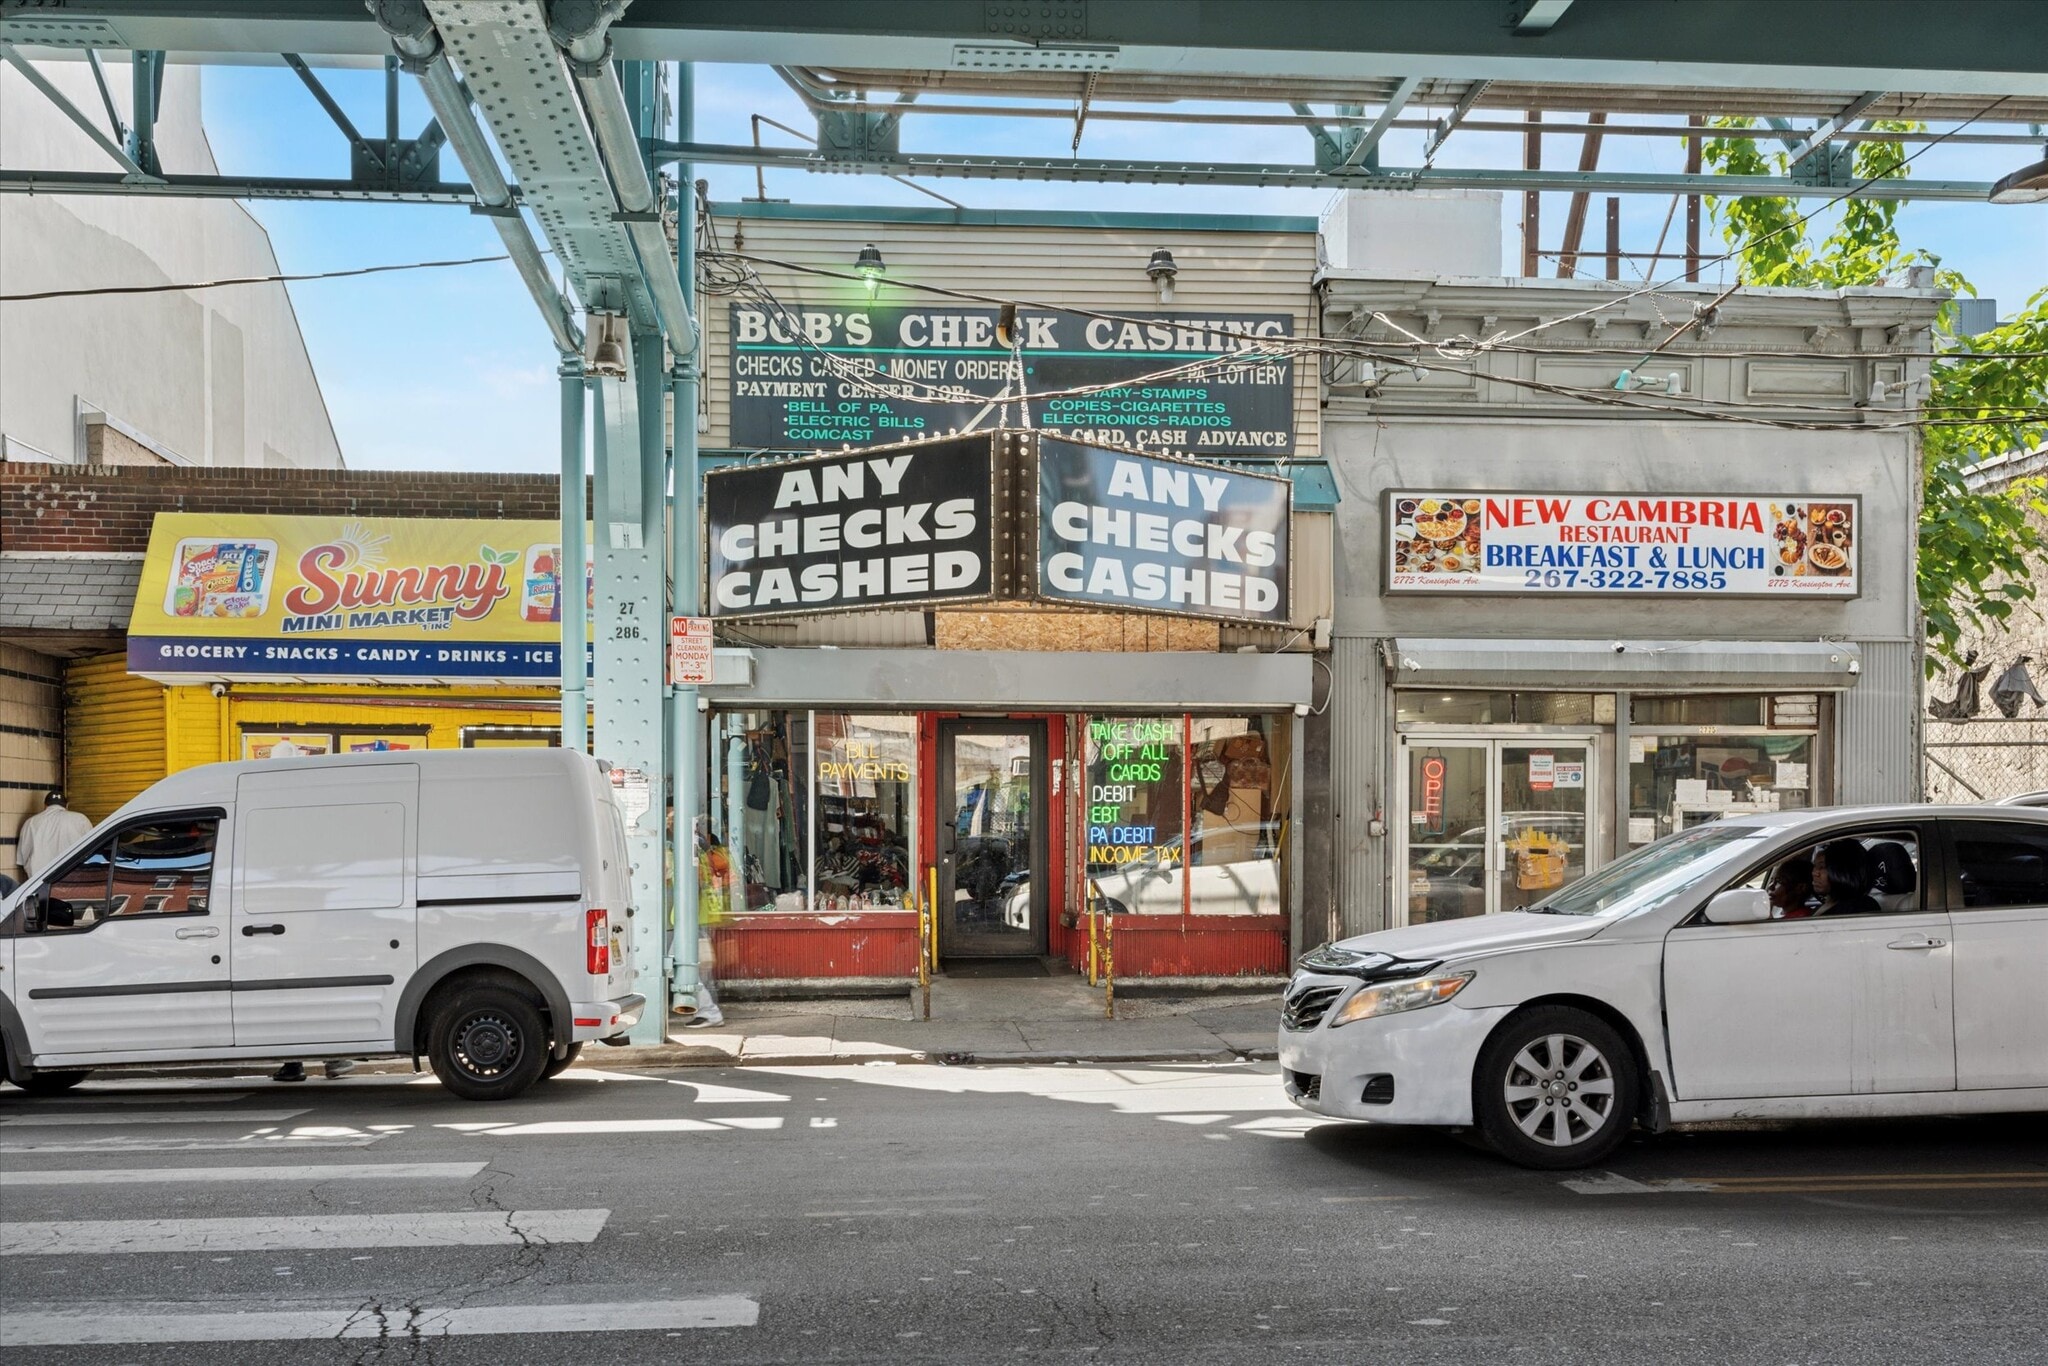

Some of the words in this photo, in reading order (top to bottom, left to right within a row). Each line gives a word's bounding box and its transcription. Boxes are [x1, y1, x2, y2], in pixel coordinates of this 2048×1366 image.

[736, 311, 873, 346] BOB'S
[900, 314, 1059, 350] CHECK
[1085, 319, 1288, 352] CASHING
[736, 356, 803, 377] CHECKS
[810, 357, 875, 379] CASHED
[891, 359, 948, 381] MONEY
[955, 361, 1020, 381] ORDERS
[1217, 364, 1287, 386] LOTTERY
[736, 381, 828, 398] PAYMENT
[837, 382, 914, 399] CENTER
[788, 401, 831, 413] BELL
[838, 402, 861, 414] OF
[869, 403, 894, 415] PA.
[1049, 400, 1226, 414] COPIES-CIGARETTES
[788, 415, 871, 428] ELECTRIC
[878, 416, 925, 429] BILLS
[1042, 413, 1232, 427] ELECTRONICS-RADIOS
[788, 428, 874, 441] COMCAST
[1136, 429, 1187, 446] CASH
[1197, 430, 1288, 447] ADVANCE
[773, 454, 914, 510] ANY
[1107, 459, 1230, 513] ANY
[1485, 498, 1572, 531] NEW
[1585, 499, 1765, 535] CAMBRIA
[719, 498, 977, 562] CHECKS
[1051, 501, 1276, 568] CHECKS
[1559, 525, 1692, 544] RESTAURANT
[1486, 544, 1640, 568] BREAKFAST
[1648, 545, 1668, 570] &
[1677, 546, 1765, 570] LUNCH
[285, 543, 511, 621] Sunny
[533, 584, 556, 593] RUFFLE
[716, 549, 982, 609] CASHED
[1046, 551, 1279, 613] CASHED
[1393, 575, 1415, 586] 2775
[1417, 575, 1461, 586] Kensington
[1524, 569, 1727, 590] 267-322-7885
[1767, 578, 1790, 588] 2775
[1791, 578, 1834, 591] Kensington
[619, 602, 635, 615] 27
[282, 612, 344, 634] MINI
[349, 606, 456, 628] MARKET
[430, 622, 450, 631] INC
[673, 620, 687, 634] NO
[615, 626, 640, 639] 286
[160, 644, 248, 659] GROCERY
[265, 646, 339, 661] SNACKS
[357, 648, 420, 662] CANDY
[438, 649, 507, 663] DRINKS
[524, 650, 554, 664] ICE
[675, 652, 710, 660] MONDAY
[676, 644, 708, 652] CLEANING
[1090, 722, 1128, 741] TAKE
[1132, 723, 1174, 741] CASH
[845, 741, 880, 759] BILL
[1103, 743, 1134, 761] OFF
[1140, 743, 1170, 761] ALL
[819, 762, 910, 782] PAYMENTS
[1110, 763, 1162, 782] CARDS
[1092, 785, 1136, 803] DEBIT
[1424, 760, 1445, 830] OPEN
[1091, 805, 1121, 824] EBT
[1089, 826, 1109, 844] PA
[1112, 826, 1156, 845] DEBIT
[1089, 845, 1150, 864] INCOME
[1153, 845, 1182, 863] TAX
